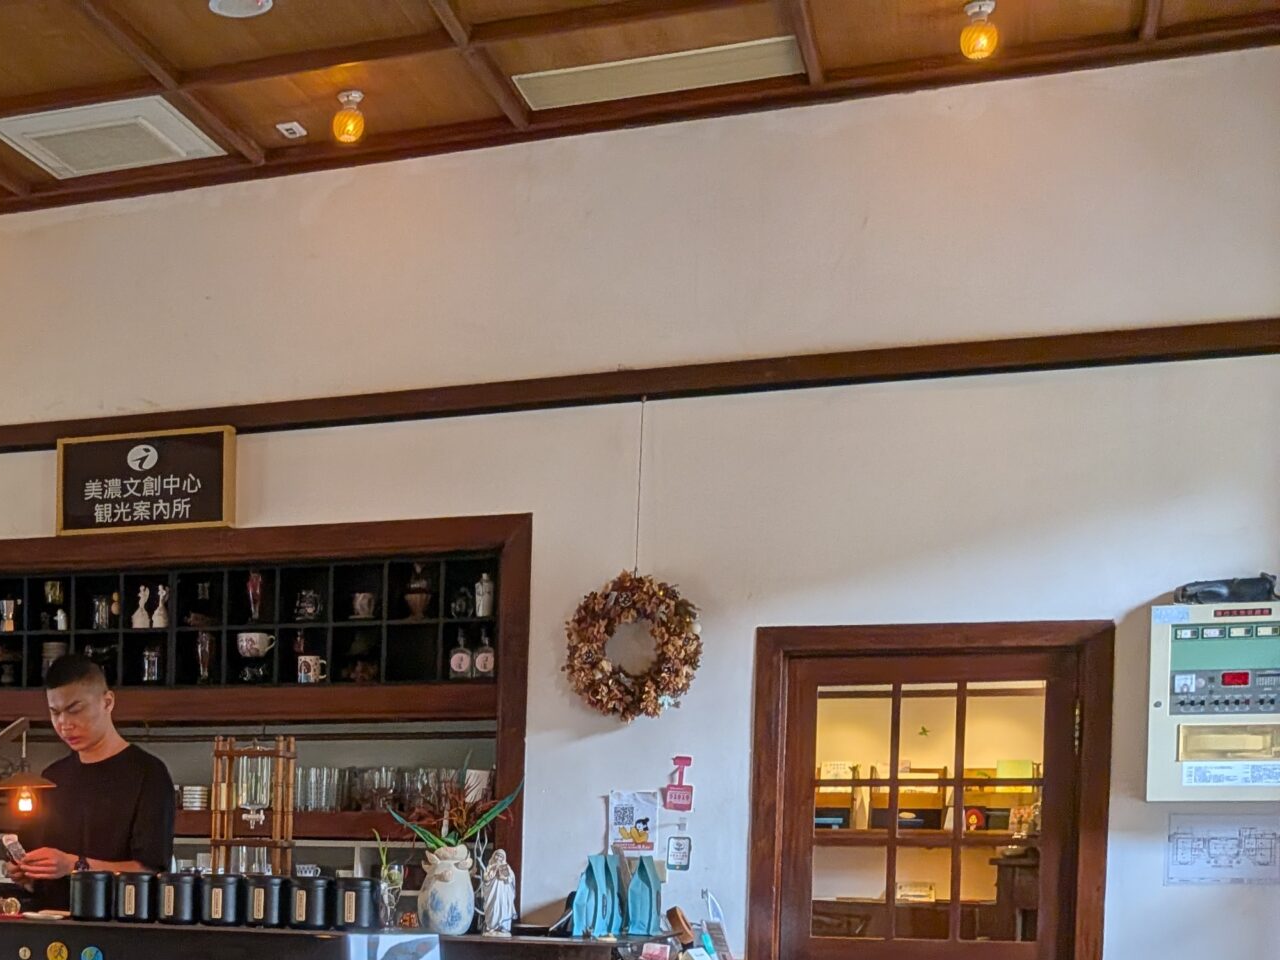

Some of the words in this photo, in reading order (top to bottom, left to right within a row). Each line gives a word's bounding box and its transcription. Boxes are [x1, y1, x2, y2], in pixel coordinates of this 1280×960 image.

[84, 473, 201, 500] 美濃文創中心
